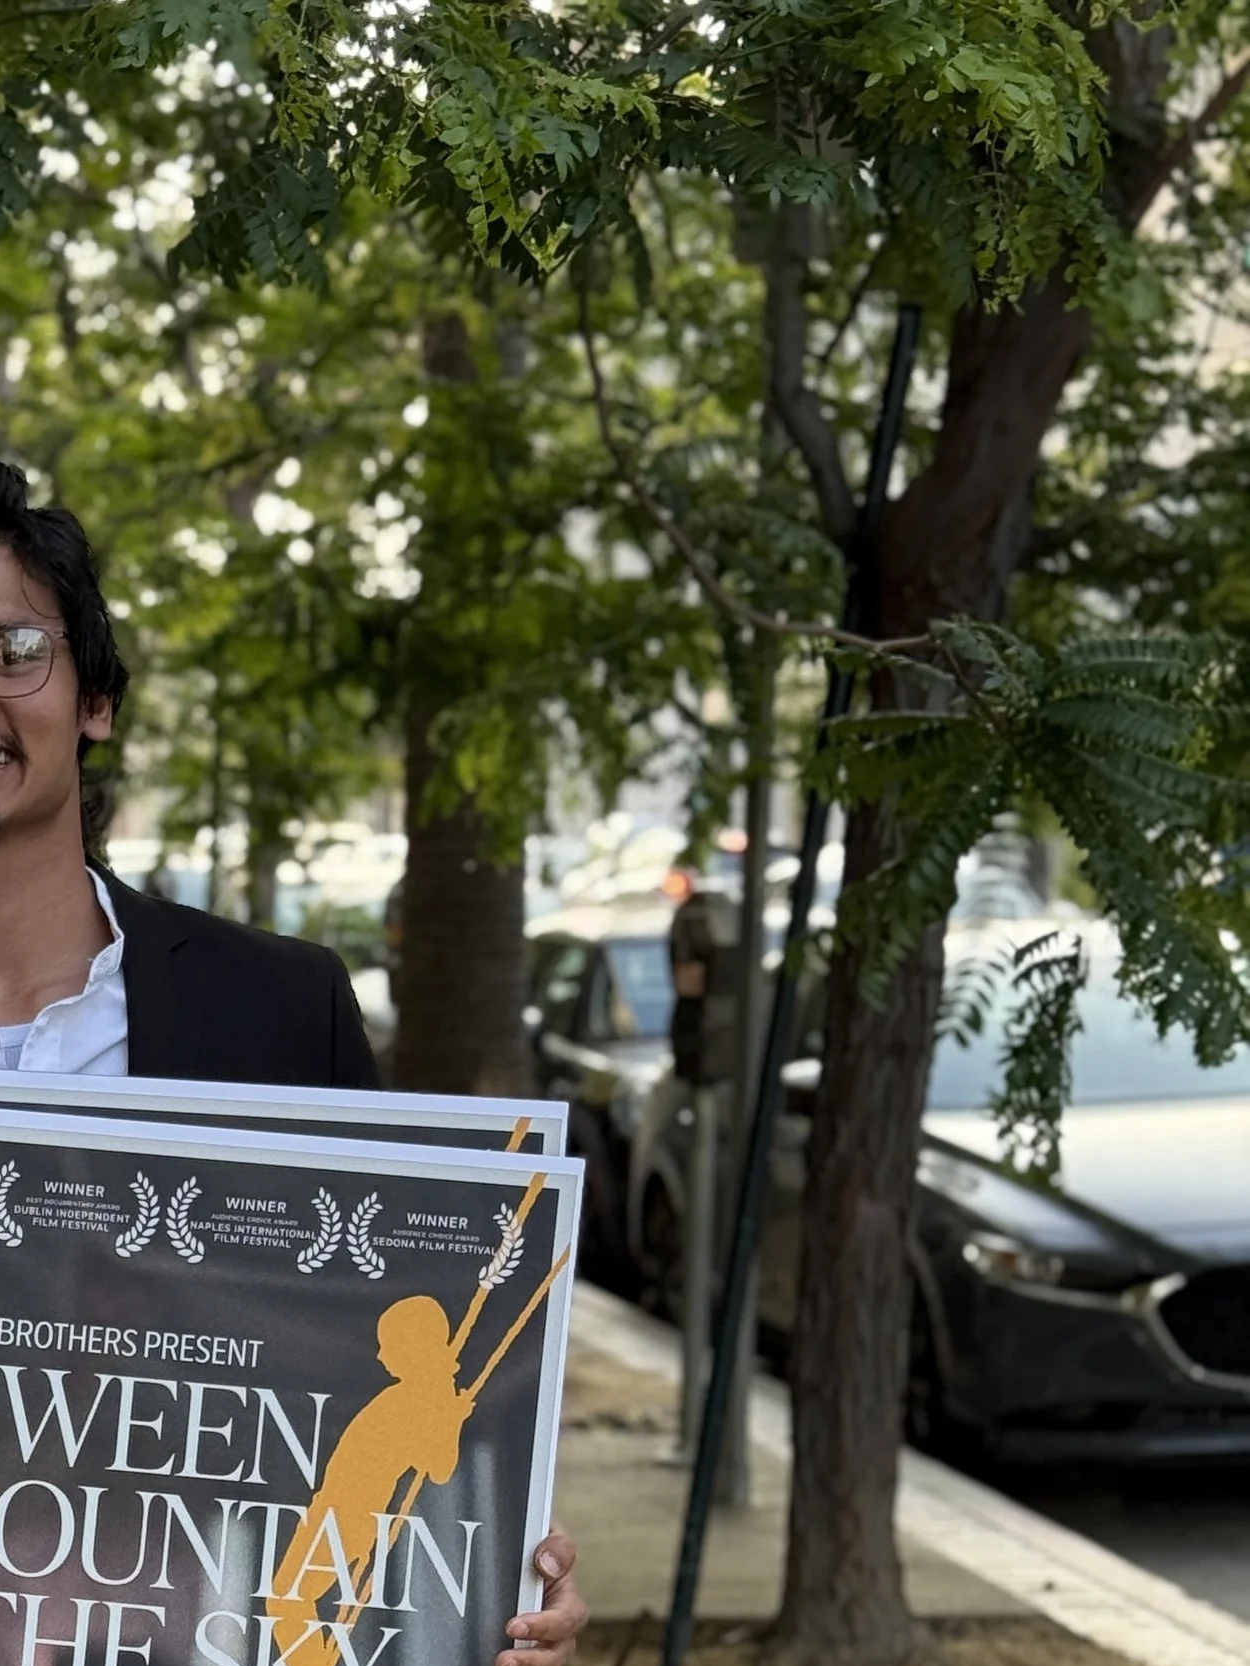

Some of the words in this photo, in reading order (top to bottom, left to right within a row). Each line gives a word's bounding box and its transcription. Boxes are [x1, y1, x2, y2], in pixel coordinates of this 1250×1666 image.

[44, 1180, 104, 1199] WINNER
[13, 1205, 52, 1218] DUBLIN
[56, 1209, 130, 1225] INDEPENDENT
[225, 1197, 286, 1215] WINNER
[32, 1217, 57, 1229] FILM
[61, 1220, 108, 1233] FESTIVAL
[190, 1220, 230, 1234] NAPLES
[234, 1224, 316, 1242] INTERNATIONAL
[406, 1212, 468, 1231] WINNER
[213, 1233, 238, 1245] FILM
[242, 1236, 290, 1249] FESTIVAL
[372, 1237, 415, 1250] SEDONA
[418, 1241, 444, 1253] FILM
[448, 1243, 496, 1257] FESTIVAL
[144, 1328, 265, 1369] PRESENT
